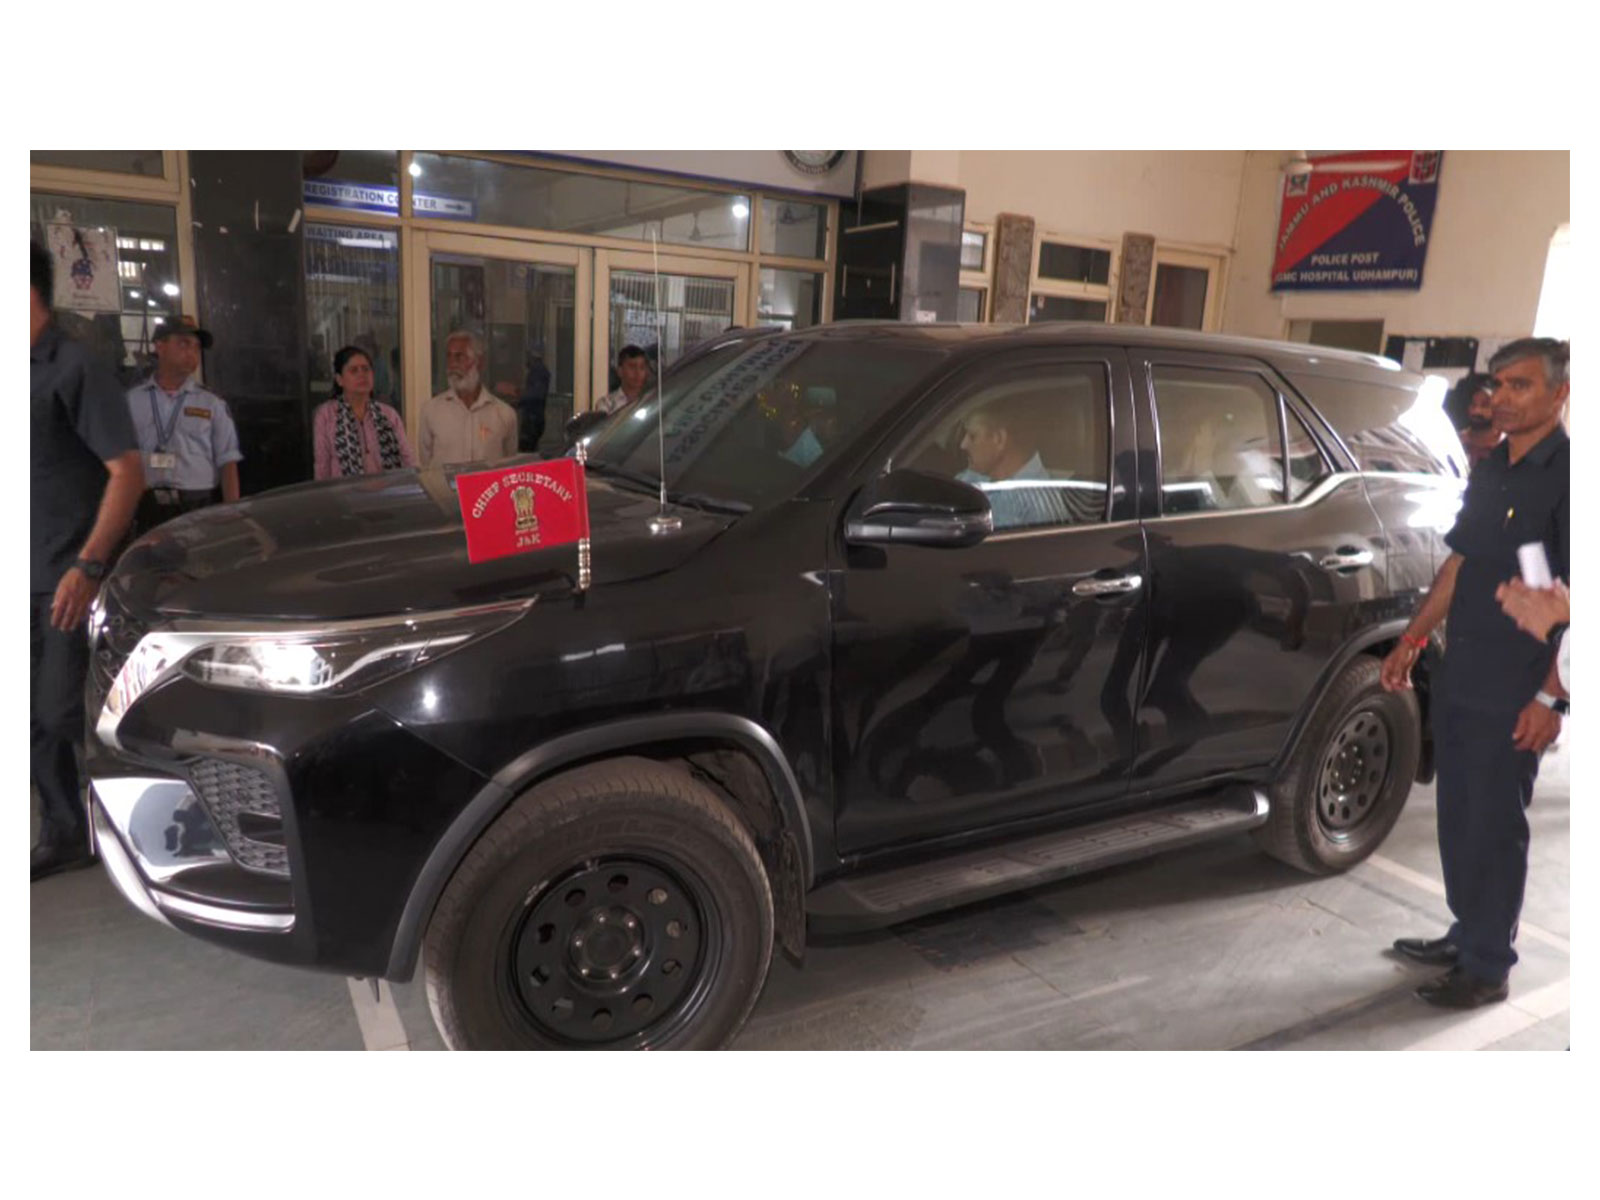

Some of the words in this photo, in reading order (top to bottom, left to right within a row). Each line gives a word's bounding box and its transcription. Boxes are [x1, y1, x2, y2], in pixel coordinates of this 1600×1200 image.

[304, 182, 384, 203] REGISTRATION
[1279, 203, 1309, 250] JAMMU
[1312, 183, 1339, 204] AND
[1342, 174, 1399, 199] KASHMIR
[1398, 193, 1426, 247] POLICE
[307, 226, 353, 239] WAITING
[356, 230, 385, 241] AREA
[1311, 253, 1348, 265] POLICE
[1350, 252, 1379, 265] POST
[1300, 270, 1349, 282] HOSPITAL
[1353, 268, 1418, 281] UDHAMPUR)
[472, 481, 499, 518] CHIEF
[502, 472, 573, 502] SECRETARY
[516, 533, 541, 548] J&K
